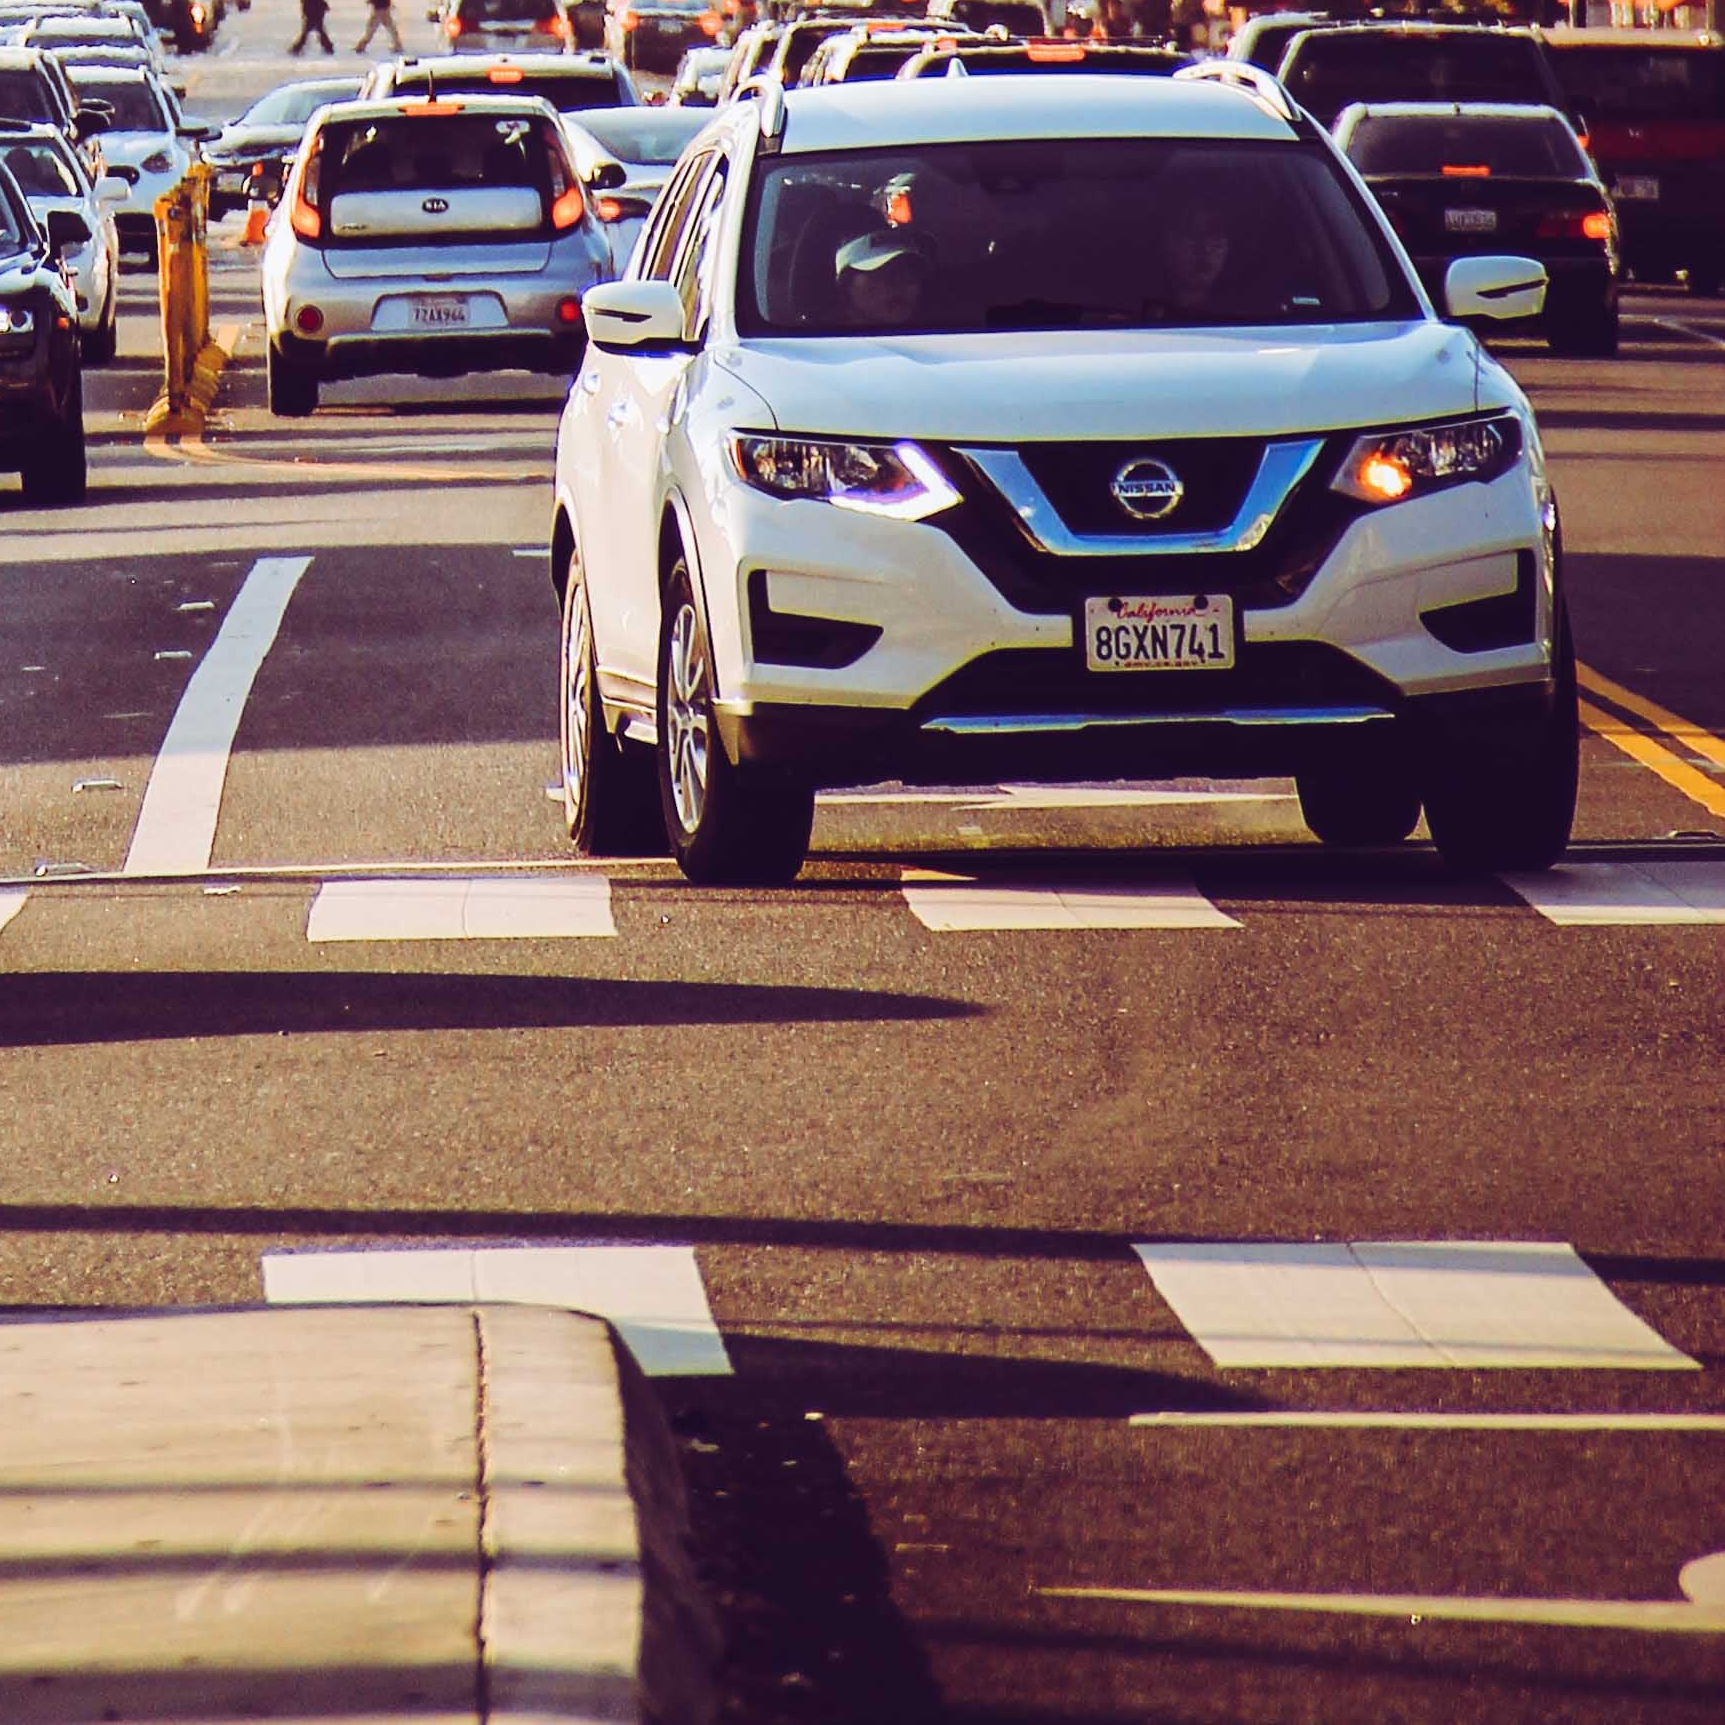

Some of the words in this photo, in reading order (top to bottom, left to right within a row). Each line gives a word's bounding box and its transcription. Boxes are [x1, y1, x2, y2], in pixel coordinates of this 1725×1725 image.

[1118, 482, 1176, 494] NISSAN
[1117, 601, 1204, 624] California
[1095, 623, 1225, 661] 8GXN741
